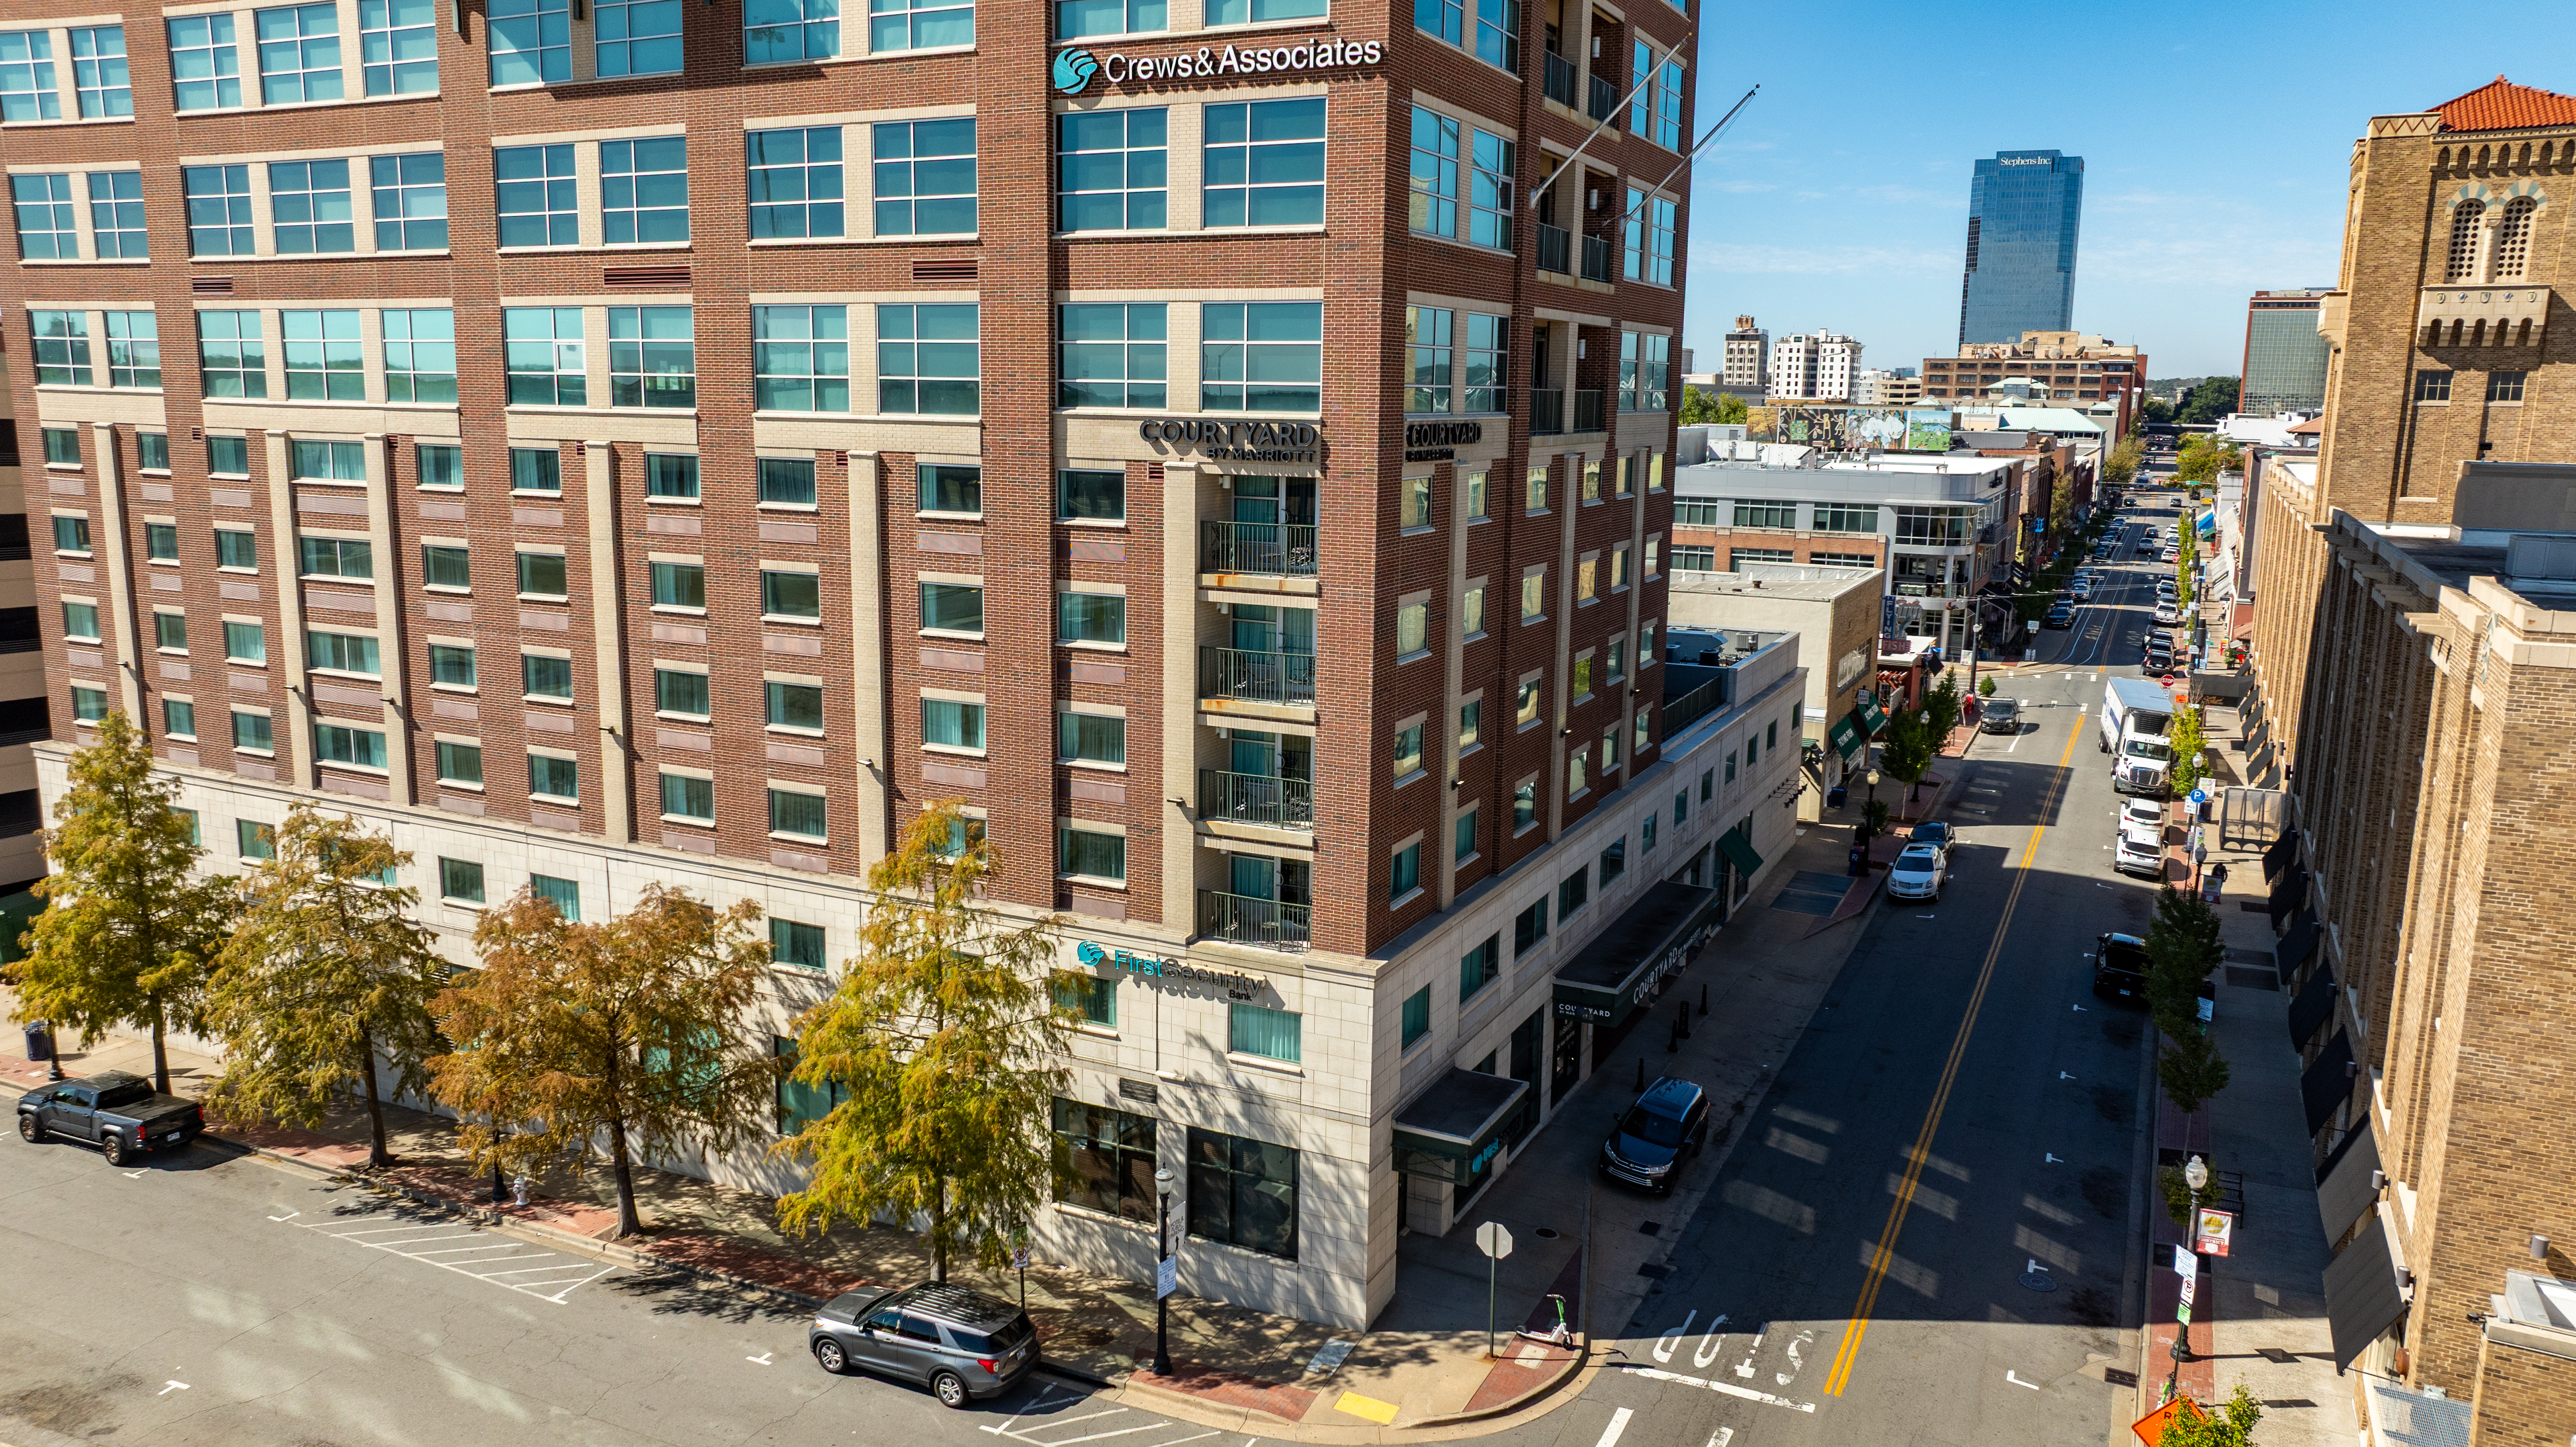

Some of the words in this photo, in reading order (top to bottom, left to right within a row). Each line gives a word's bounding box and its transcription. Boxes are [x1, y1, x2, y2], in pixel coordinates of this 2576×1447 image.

[1105, 53, 1192, 83] Crews
[1195, 46, 1215, 76] &
[1217, 38, 1381, 75] Associates
[2000, 157, 2037, 167] Stephens
[2037, 156, 2052, 165] Inc.
[1139, 419, 1317, 447] COURTYARD
[1408, 423, 1482, 447] COURTYARD
[1206, 447, 1230, 460] BY
[1231, 447, 1315, 463] MARRIOTT
[1884, 600, 1894, 638] FLYING
[1882, 640, 1906, 651] FISH
[1633, 947, 1678, 1004] COURTYARD
[1229, 989, 1253, 1002] Bank
[1170, 1218, 1181, 1228] HOTEL
[1171, 1221, 1182, 1233] PUBLIC
[1170, 1226, 1184, 1239] PARKING
[1653, 1309, 1814, 1385] STOP
